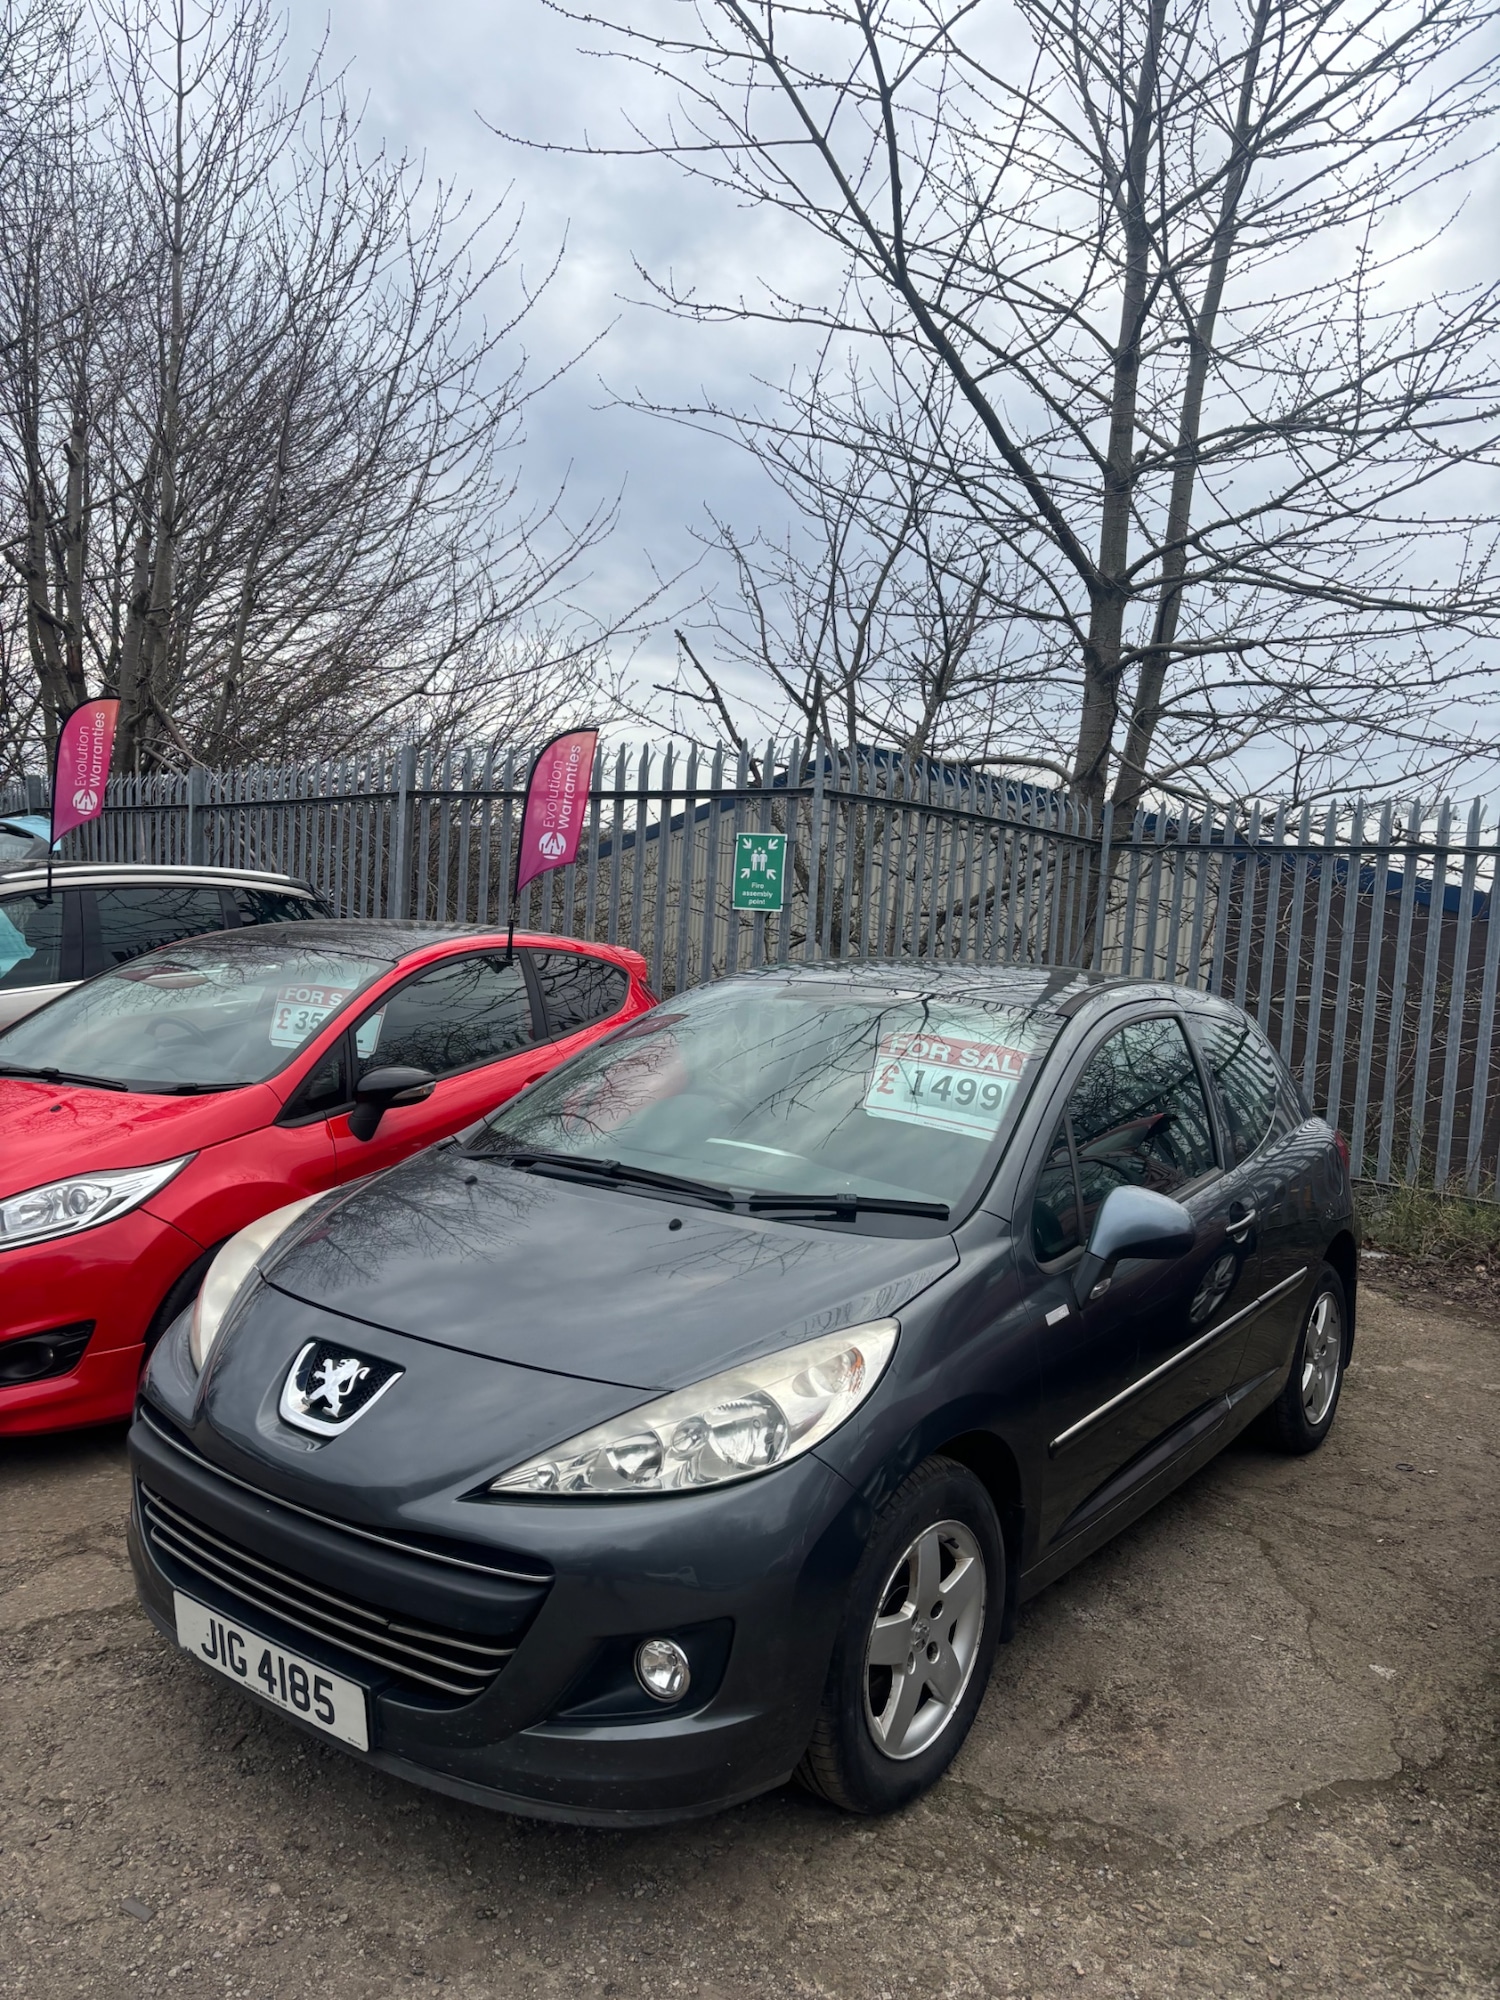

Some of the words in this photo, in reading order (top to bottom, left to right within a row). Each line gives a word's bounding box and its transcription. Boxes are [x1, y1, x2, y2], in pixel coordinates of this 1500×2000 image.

[75, 726, 89, 786] Evolution
[90, 712, 105, 787] Warranties
[543, 760, 563, 828] Evolution
[557, 745, 581, 829] Warranties
[742, 891, 773, 899] assembly
[285, 987, 325, 1004] FOR
[329, 993, 343, 1006] S
[295, 1011, 324, 1031] 35
[889, 1036, 951, 1062] FOR
[201, 1618, 248, 1678] JIG
[258, 1649, 335, 1726] 4185
